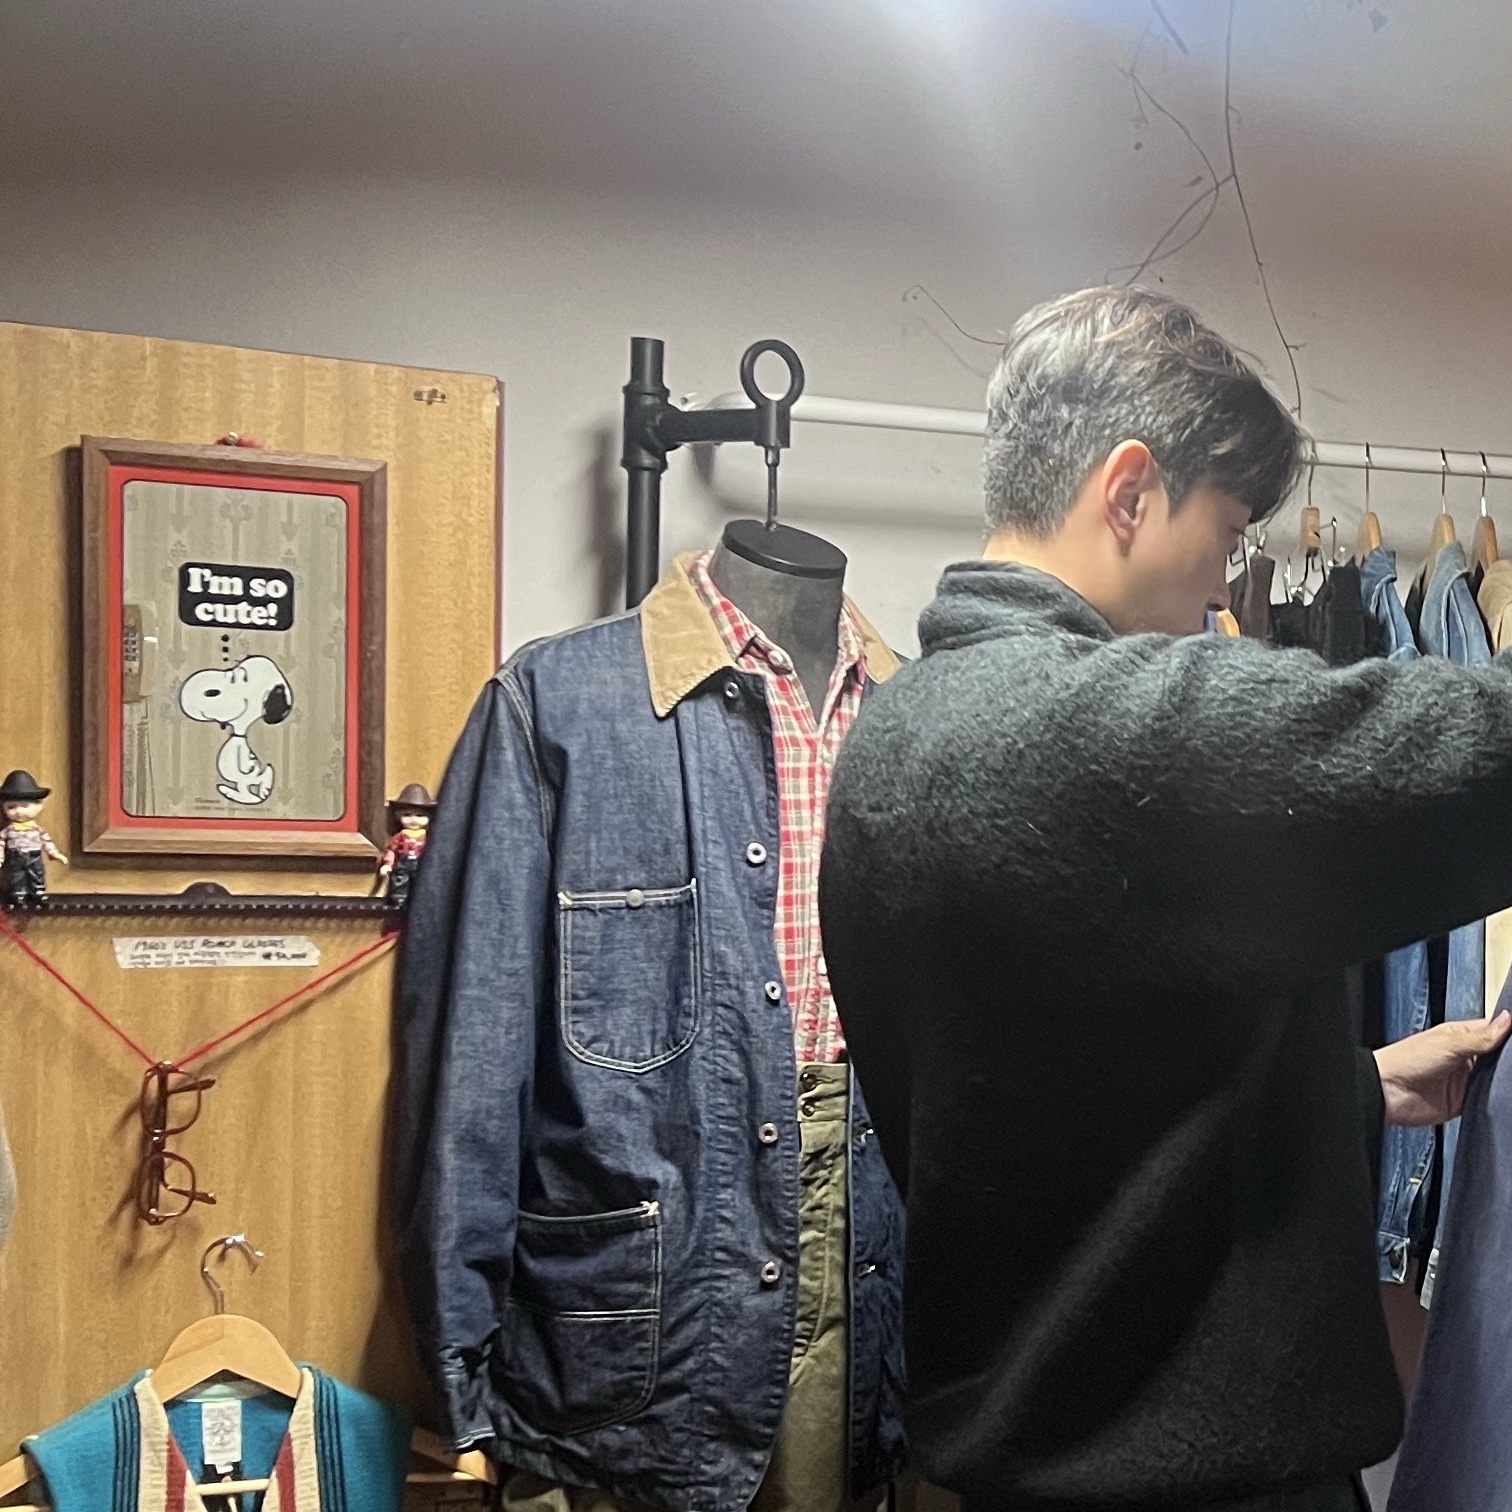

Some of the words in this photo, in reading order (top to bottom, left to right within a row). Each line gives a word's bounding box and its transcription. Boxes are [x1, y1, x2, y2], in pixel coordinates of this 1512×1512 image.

[187, 567, 244, 595] I'm
[249, 578, 288, 598] so
[195, 601, 278, 626] cute!
